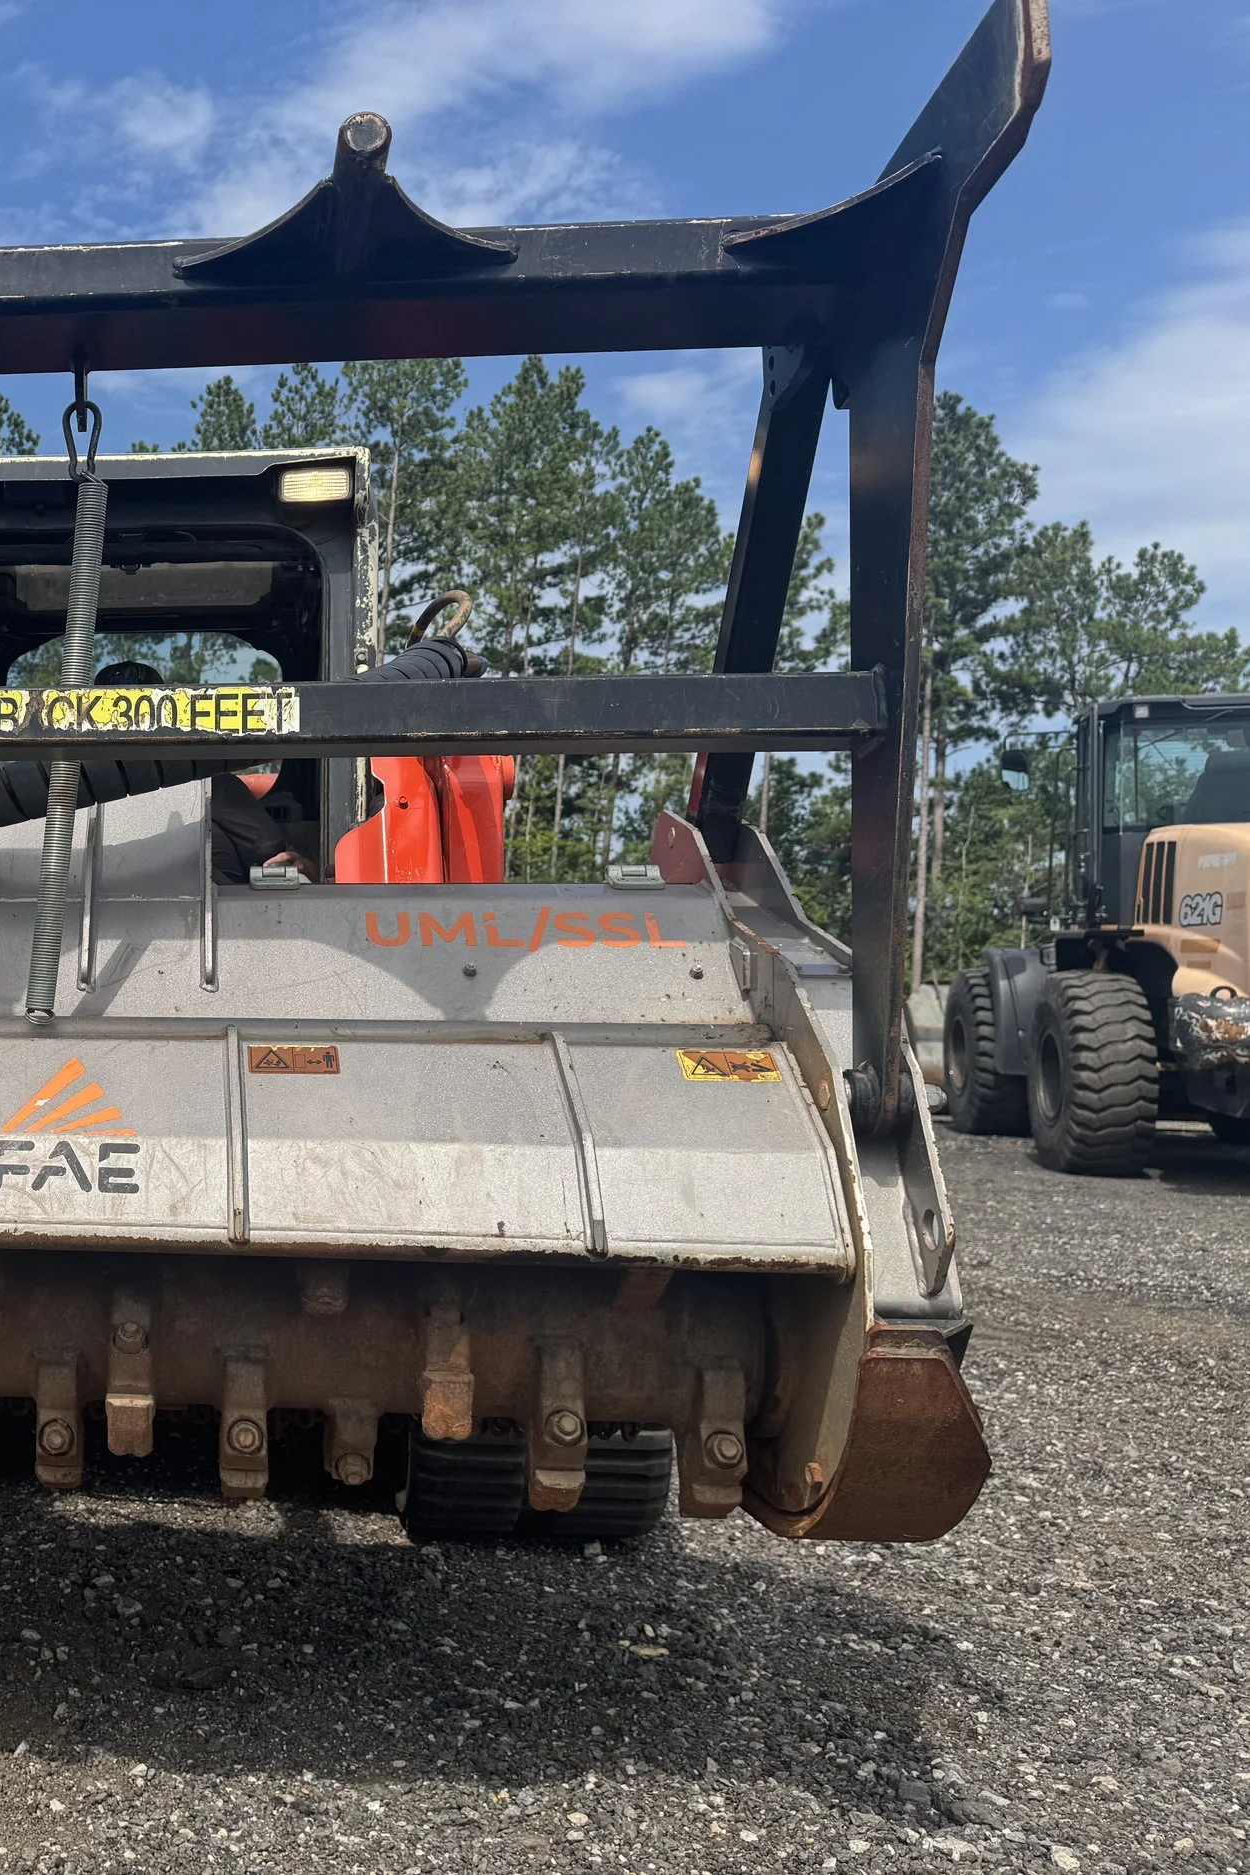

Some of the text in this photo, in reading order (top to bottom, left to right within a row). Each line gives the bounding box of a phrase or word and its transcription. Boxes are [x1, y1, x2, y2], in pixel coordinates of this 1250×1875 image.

[113, 695, 178, 730] 300
[190, 692, 293, 734] FEET
[365, 906, 687, 952] UML/SSL
[1179, 891, 1223, 927] 621G
